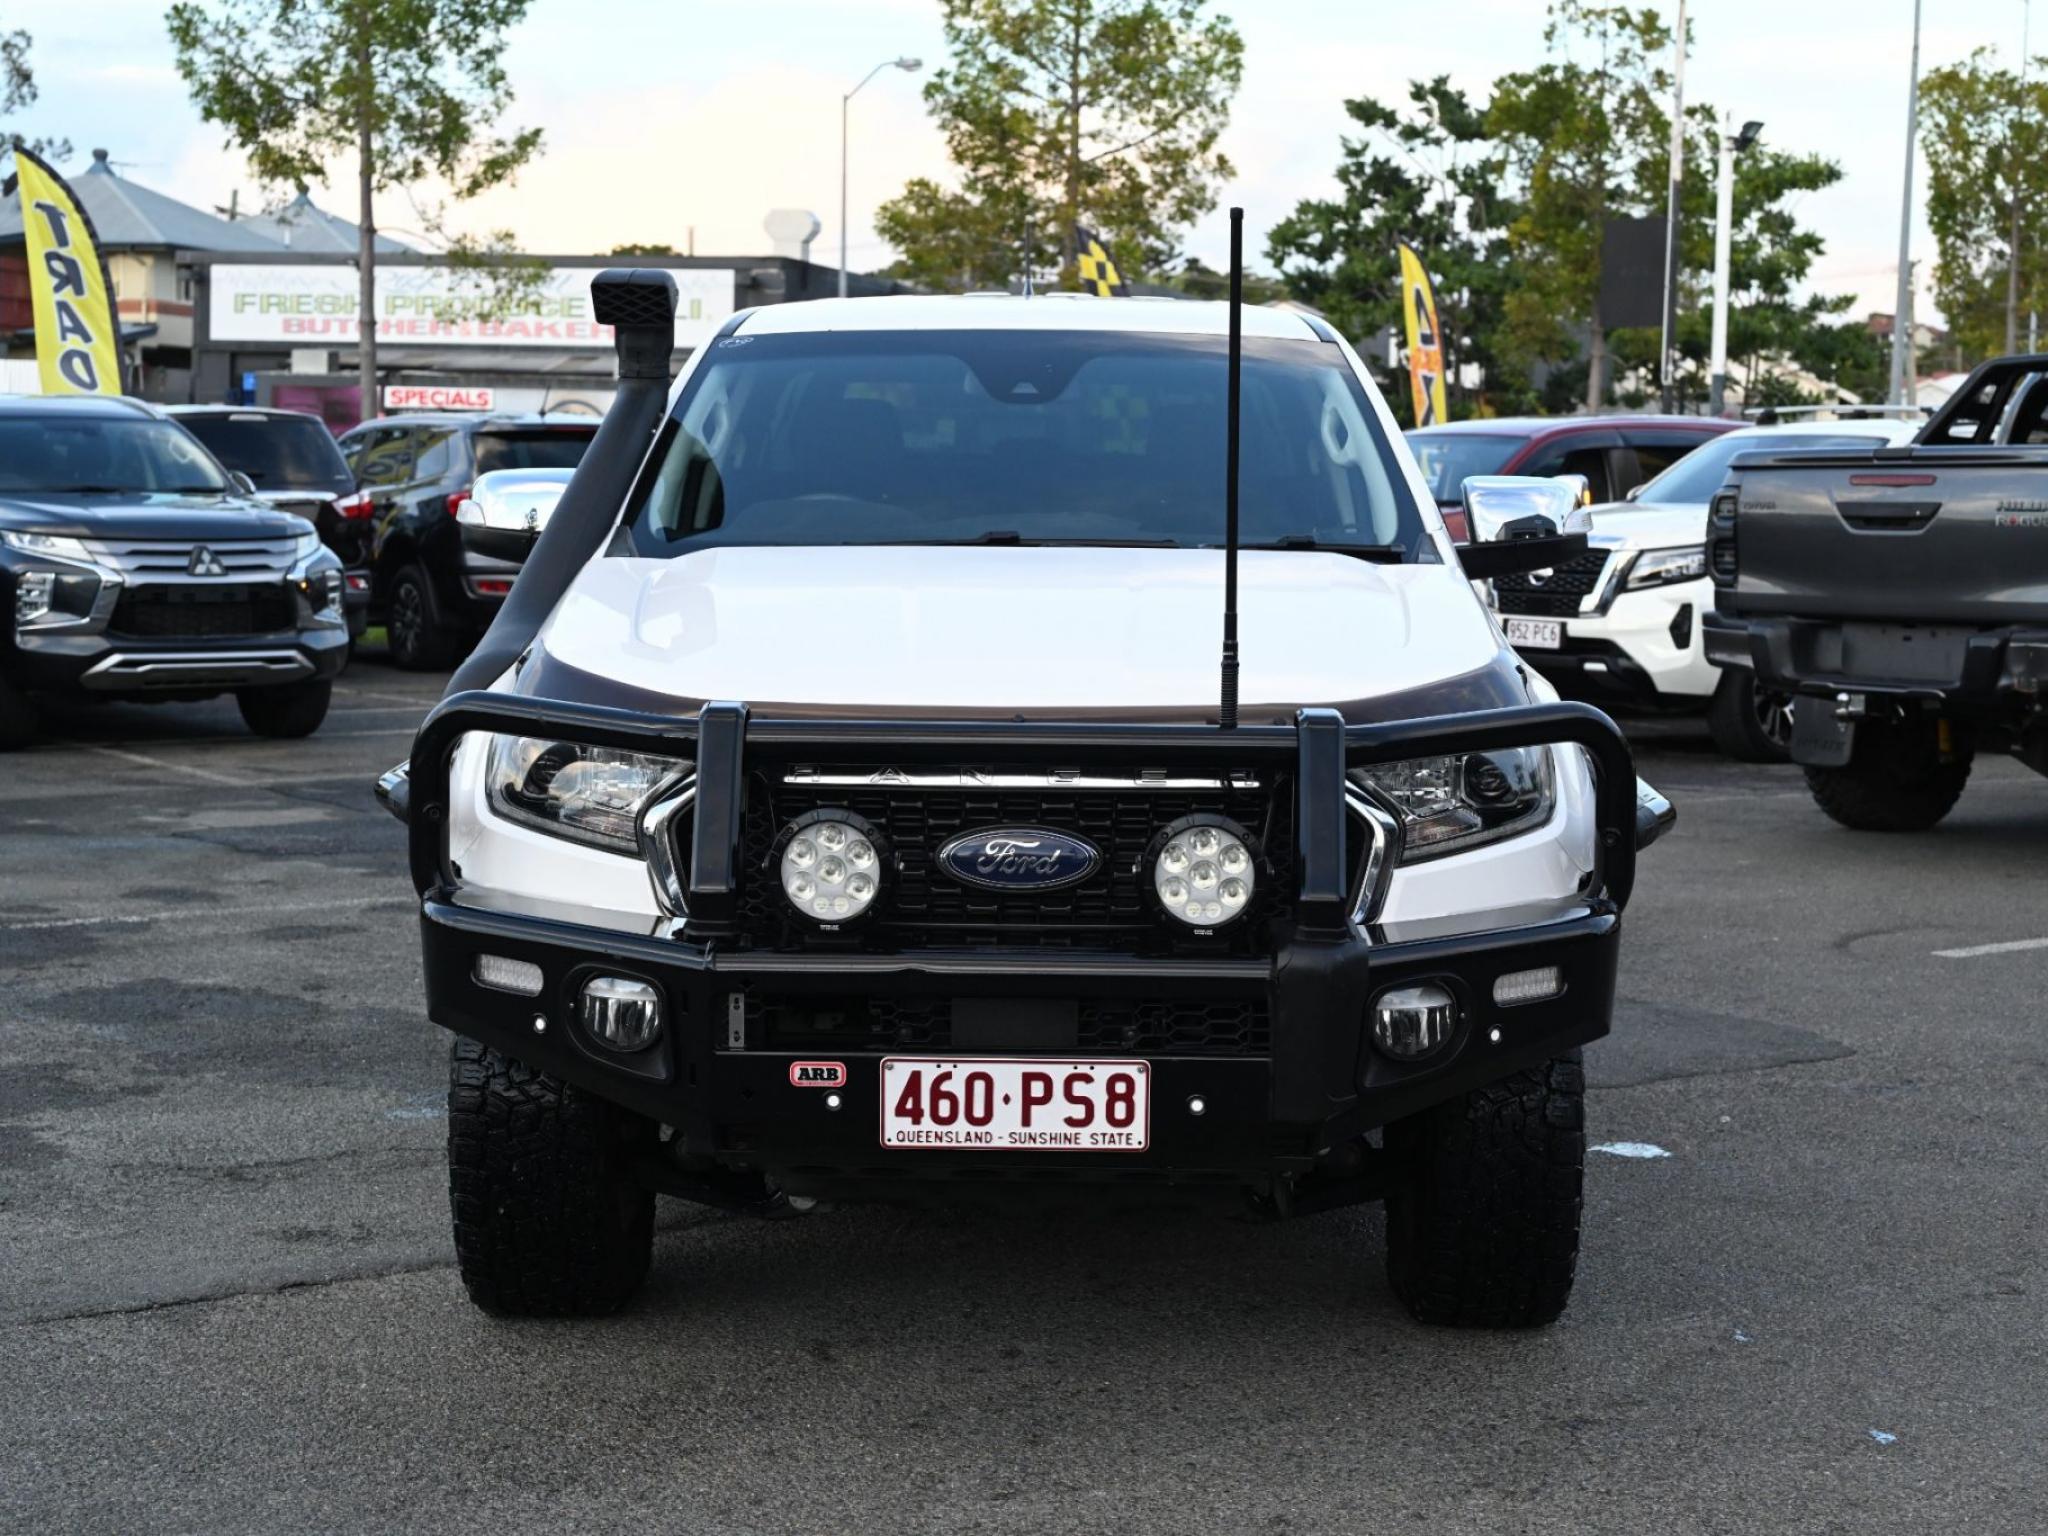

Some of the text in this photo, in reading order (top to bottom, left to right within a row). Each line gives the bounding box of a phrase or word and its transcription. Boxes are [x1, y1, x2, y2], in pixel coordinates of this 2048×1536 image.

[282, 317, 454, 336] BUTHER
[390, 389, 490, 407] SPECIALS
[977, 839, 1060, 874] Ford
[797, 1067, 839, 1081] ARB
[896, 1130, 993, 1144] QUEENSLAND
[1008, 1132, 1081, 1145] SUNSHINE
[1090, 1132, 1133, 1146] STATE
